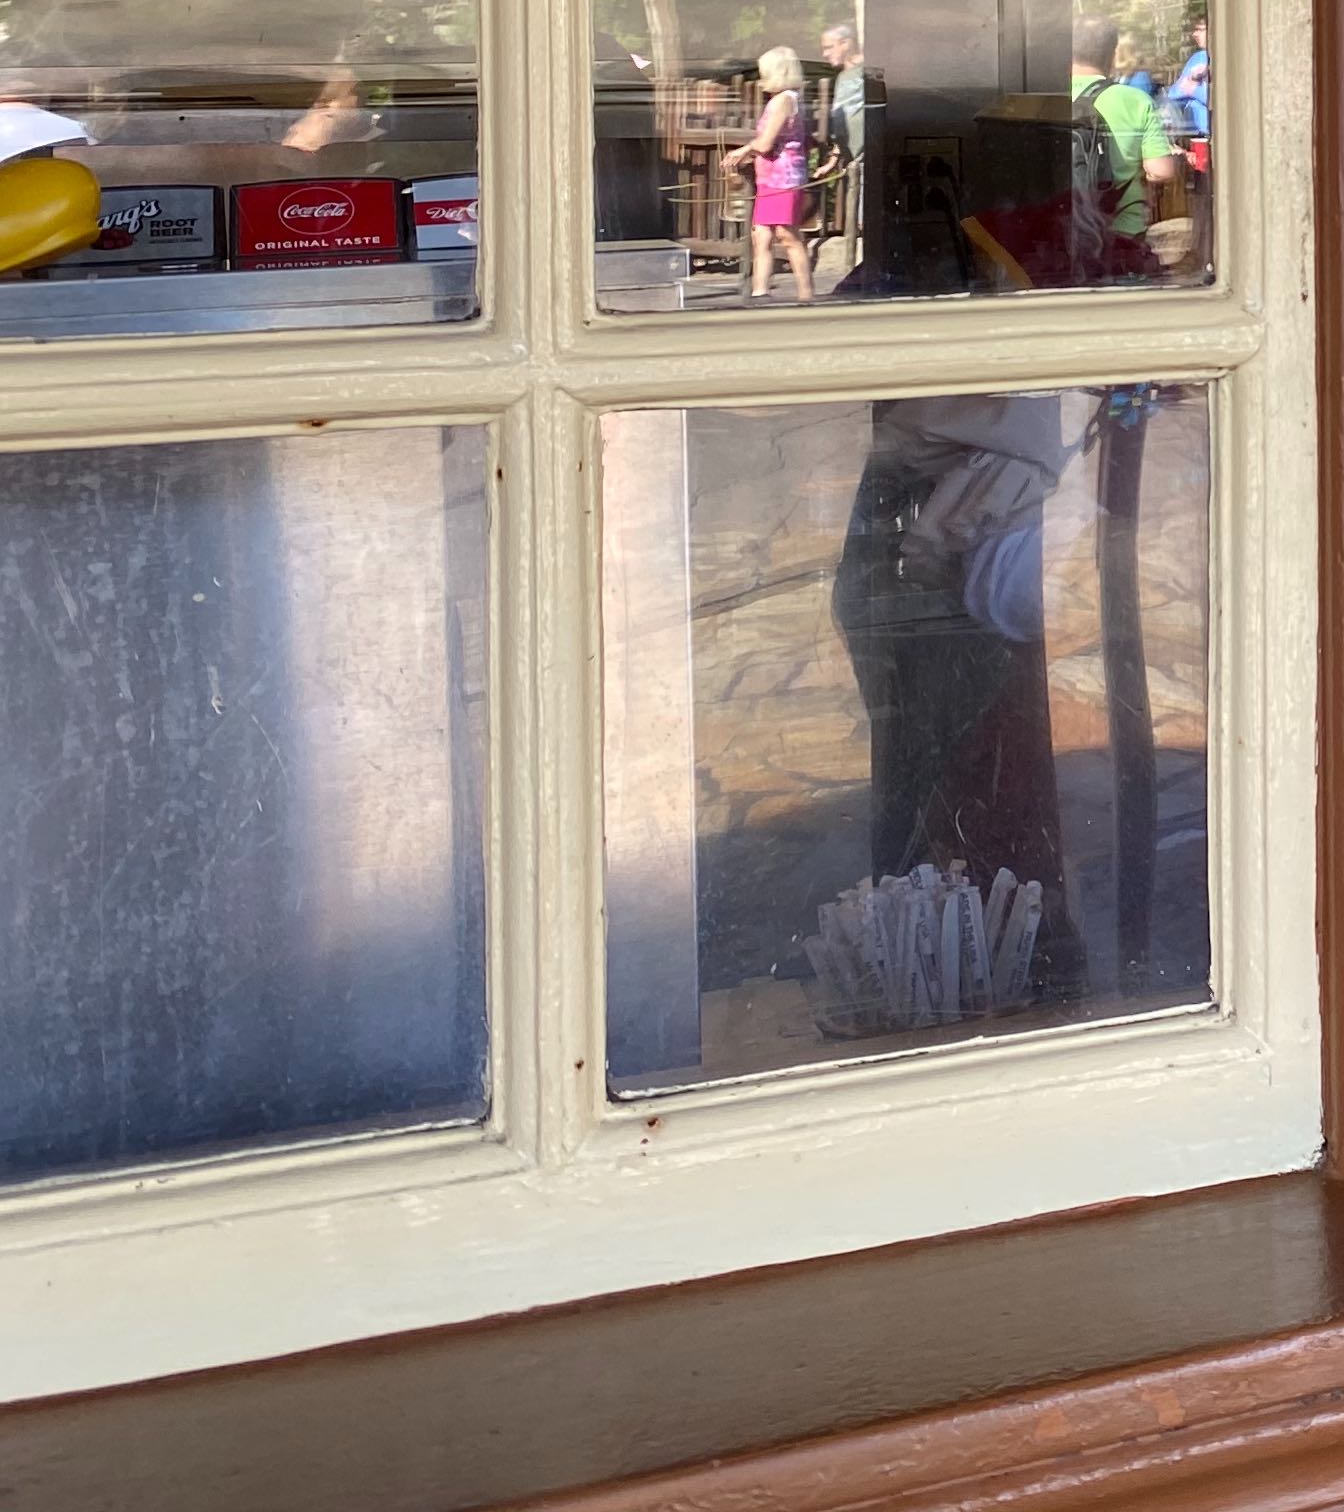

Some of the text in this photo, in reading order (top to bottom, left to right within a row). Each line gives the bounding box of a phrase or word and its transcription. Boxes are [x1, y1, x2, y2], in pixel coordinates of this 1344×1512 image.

[97, 198, 162, 235] arq's
[283, 202, 349, 219] Coca-Cola
[426, 207, 465, 222] Diet
[150, 218, 199, 228] ROOT
[150, 228, 194, 237] BEER
[254, 236, 380, 250] ORIGINAL TASTE
